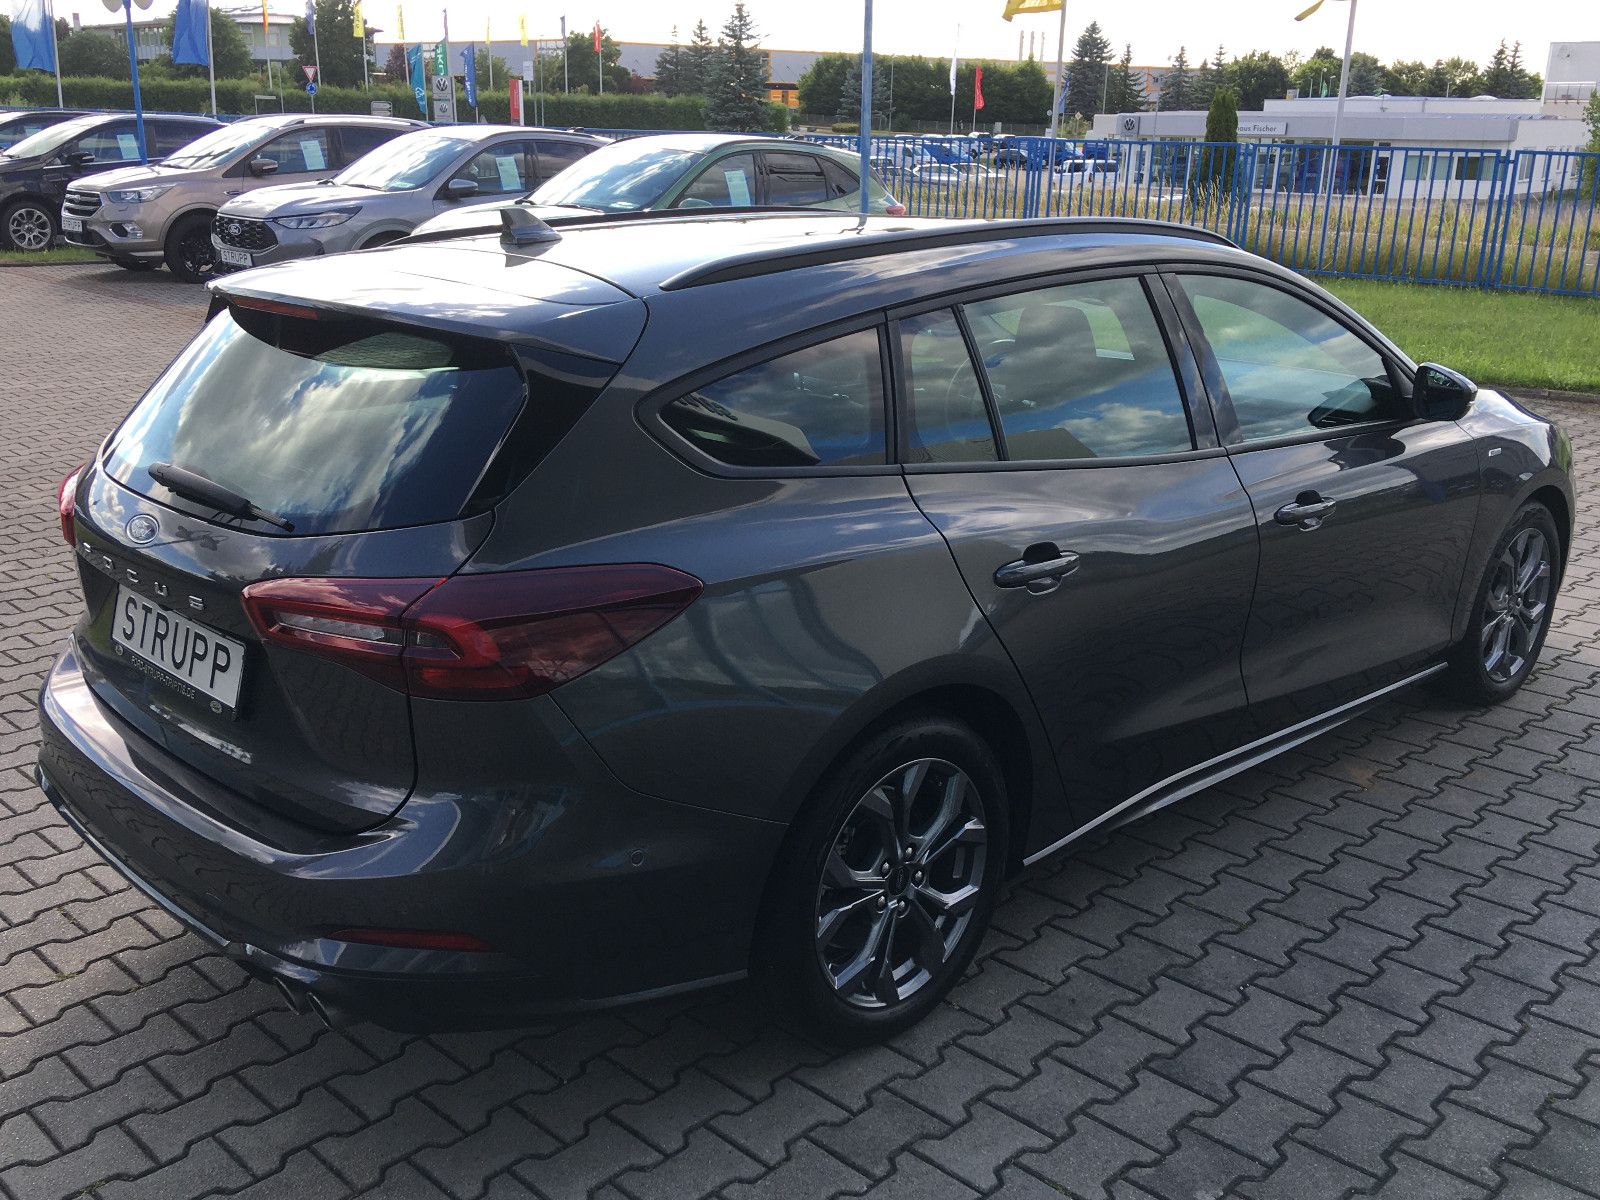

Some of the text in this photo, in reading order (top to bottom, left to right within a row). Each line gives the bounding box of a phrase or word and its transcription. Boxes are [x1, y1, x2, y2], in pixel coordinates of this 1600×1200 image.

[1253, 124, 1277, 132] Fischer
[223, 250, 248, 264] STRUPP
[122, 595, 231, 689] STRUPP
